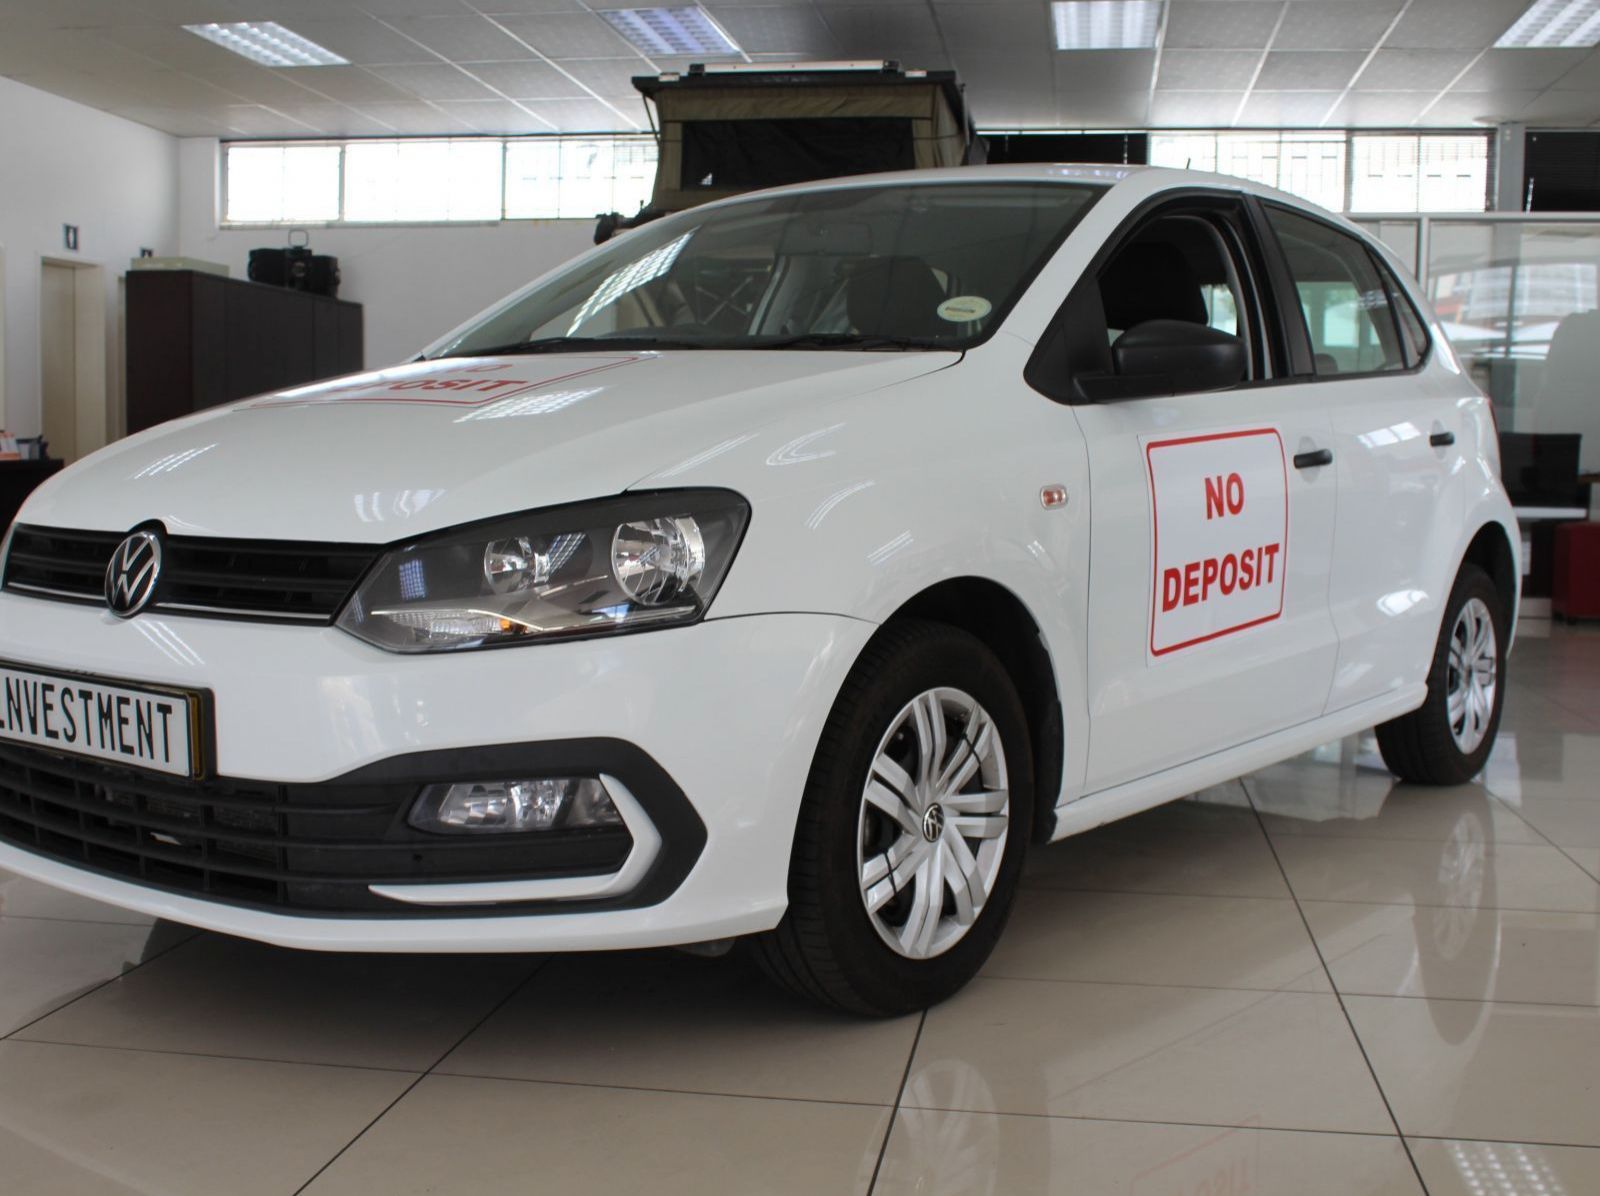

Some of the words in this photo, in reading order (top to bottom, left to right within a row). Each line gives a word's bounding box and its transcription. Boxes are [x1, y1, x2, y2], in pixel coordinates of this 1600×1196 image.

[1204, 472, 1245, 520] NO
[1162, 543, 1280, 613] DEPOSIT
[0, 676, 173, 763] NVESTMENT
